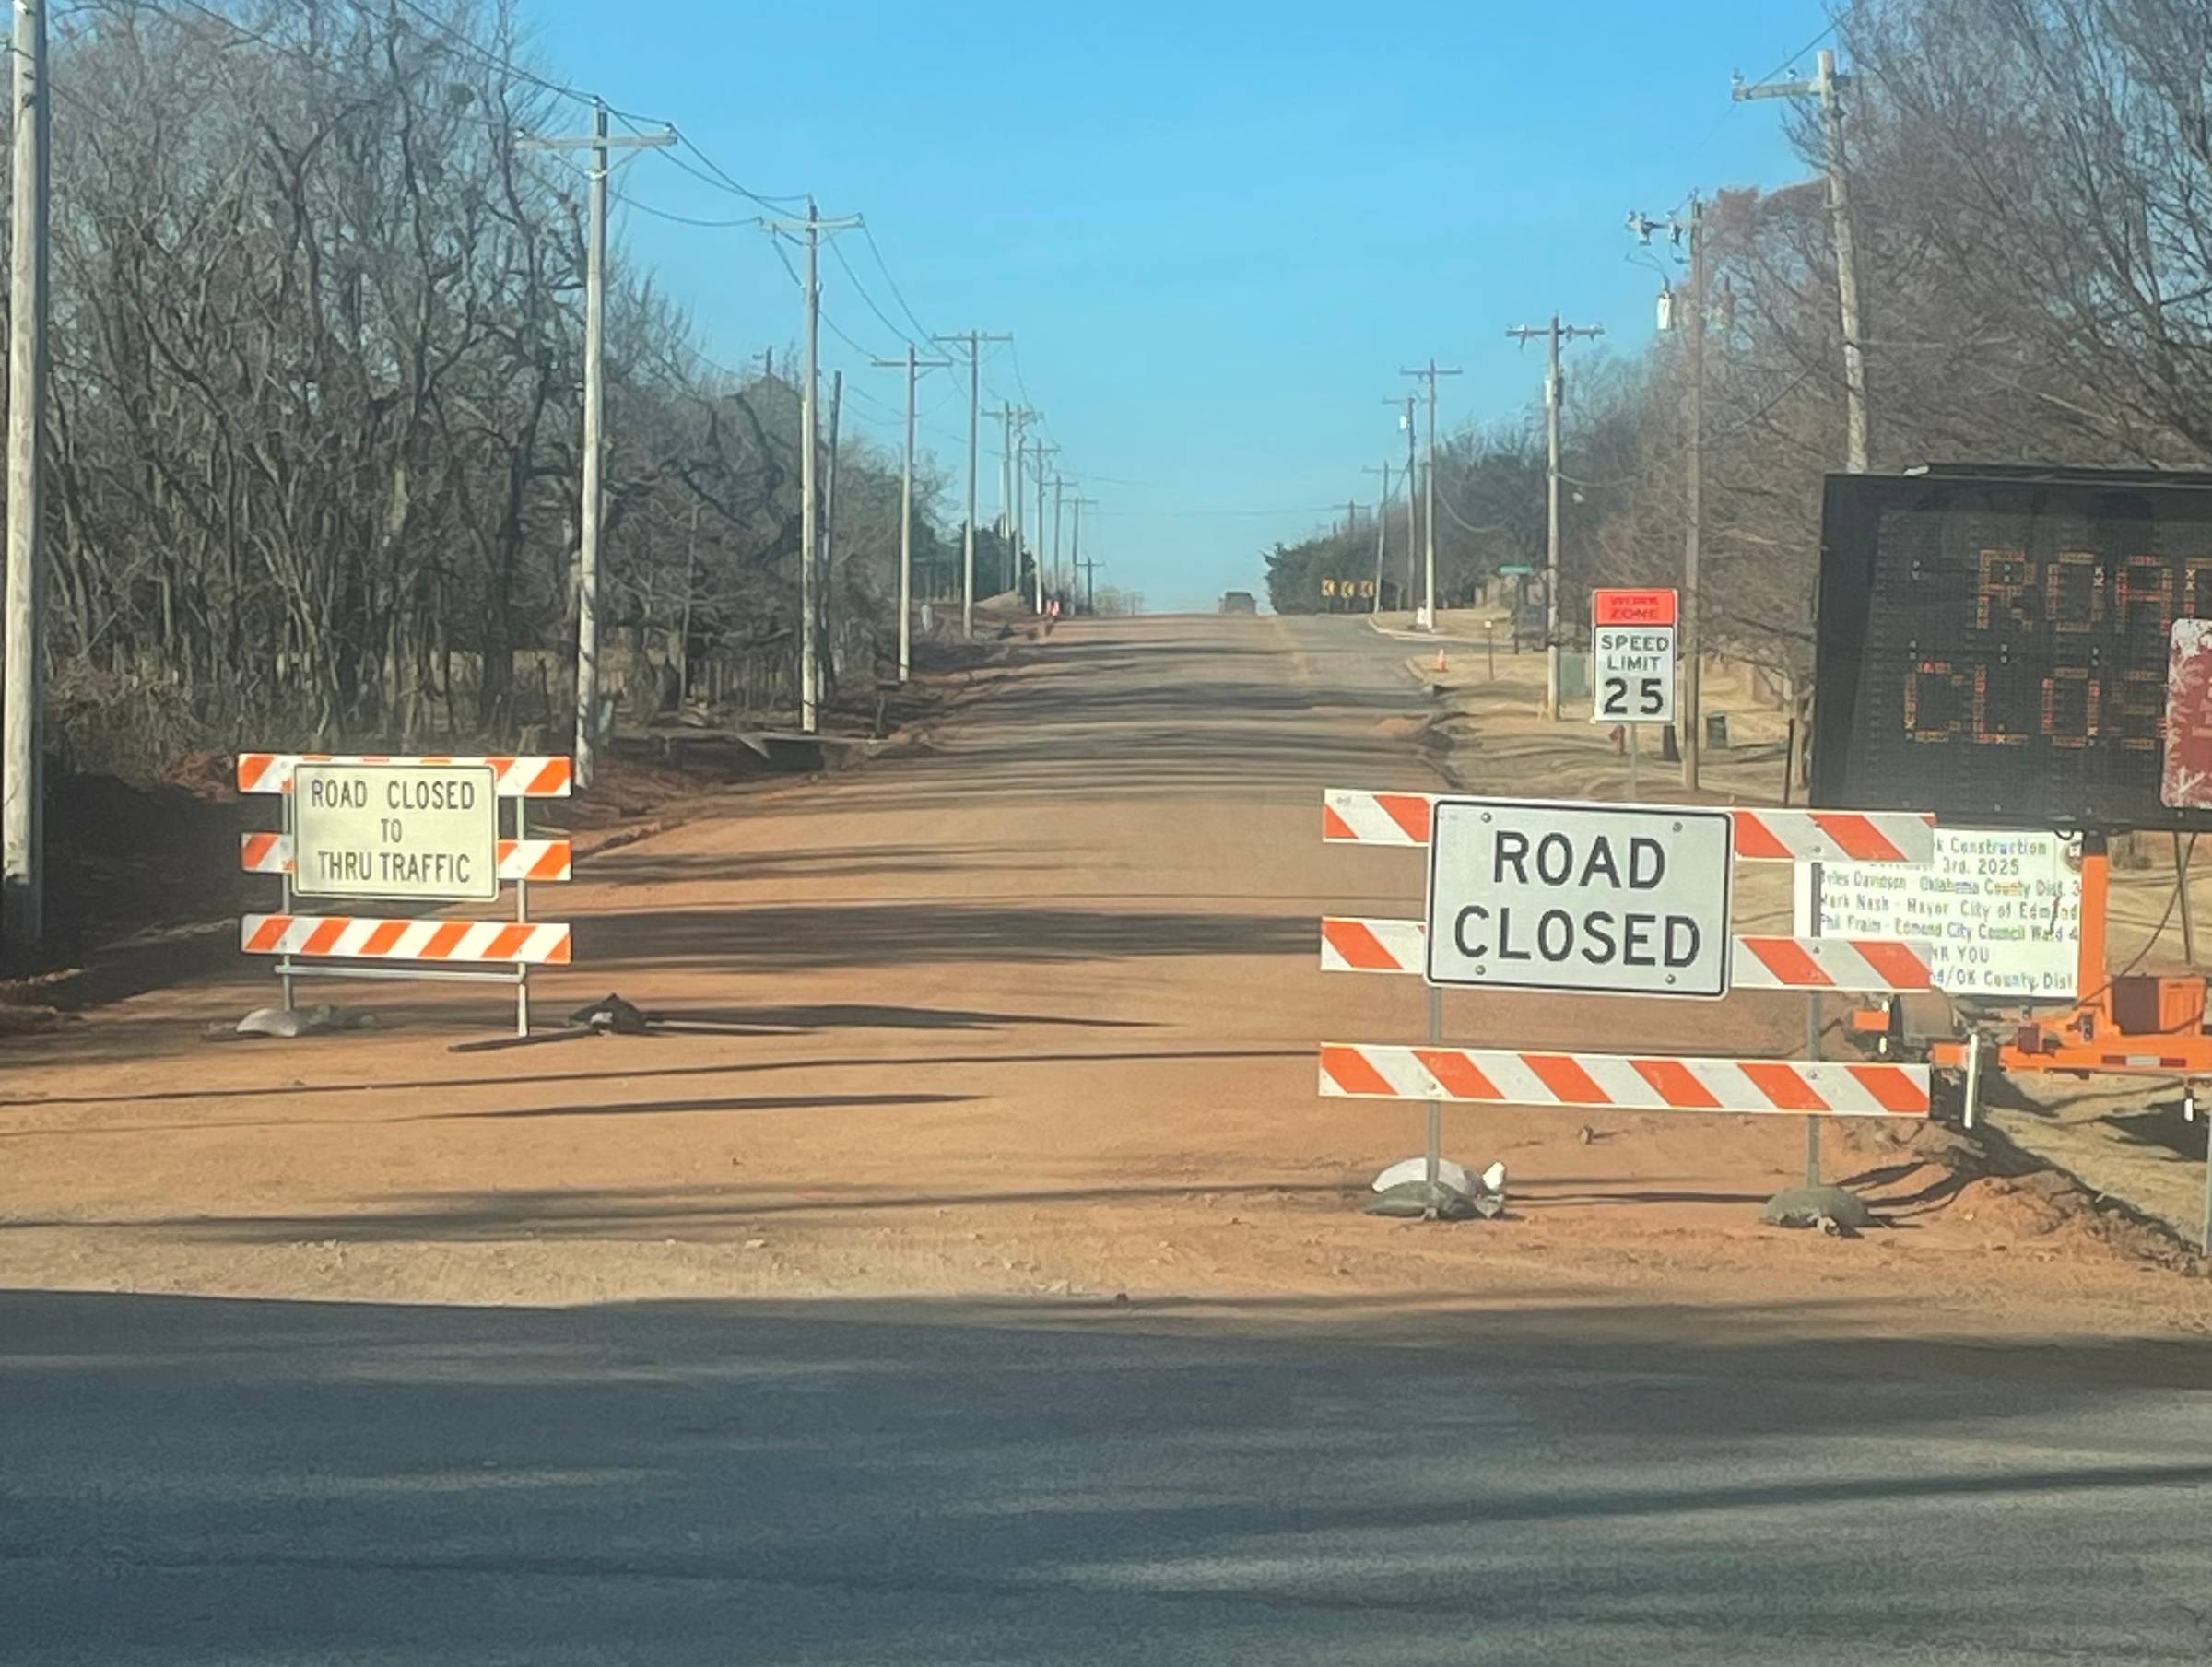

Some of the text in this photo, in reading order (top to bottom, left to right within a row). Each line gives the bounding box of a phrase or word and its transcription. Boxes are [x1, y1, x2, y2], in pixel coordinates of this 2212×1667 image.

[1601, 635, 1669, 651] SPEED
[1607, 656, 1661, 671] LIMIT
[1603, 677, 1664, 715] 25
[312, 779, 475, 810] ROAD CLOSED
[381, 818, 403, 843] TO
[1950, 836, 2047, 855] Construction
[318, 851, 471, 884] THRU TRAFFIC
[1493, 830, 1665, 890] ROAD
[1978, 858, 2019, 875] 2025
[1919, 875, 1979, 894] Oklahoma
[1856, 893, 1889, 911] Nash
[1907, 898, 1949, 916] Mayor
[1960, 899, 1991, 922] City
[1998, 901, 2011, 919] of
[1454, 905, 1700, 968] CLOSED
[1947, 922, 1971, 941] City
[1957, 946, 1990, 963] YOU
